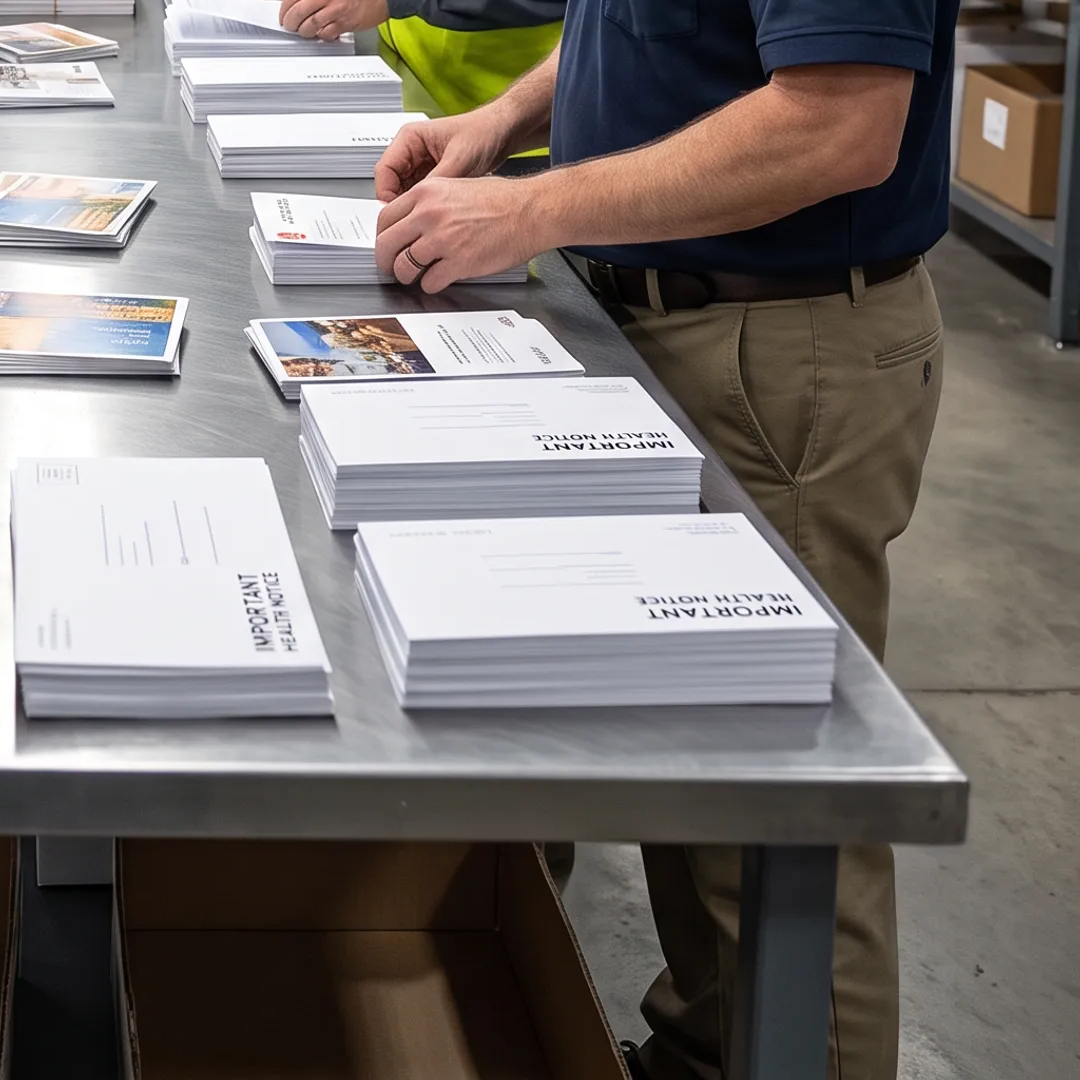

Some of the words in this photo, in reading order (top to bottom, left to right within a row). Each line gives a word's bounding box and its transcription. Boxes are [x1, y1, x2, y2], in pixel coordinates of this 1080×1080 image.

[532, 433, 597, 442] NOTICE
[542, 440, 674, 451] IMPORTANT
[262, 572, 286, 607] NOTICE
[634, 595, 708, 605] NOTICE
[714, 593, 794, 603] HEALTH
[237, 573, 275, 651] IMPORTANT
[648, 604, 803, 619] IMPORTANT
[272, 610, 299, 652] HEALTH
